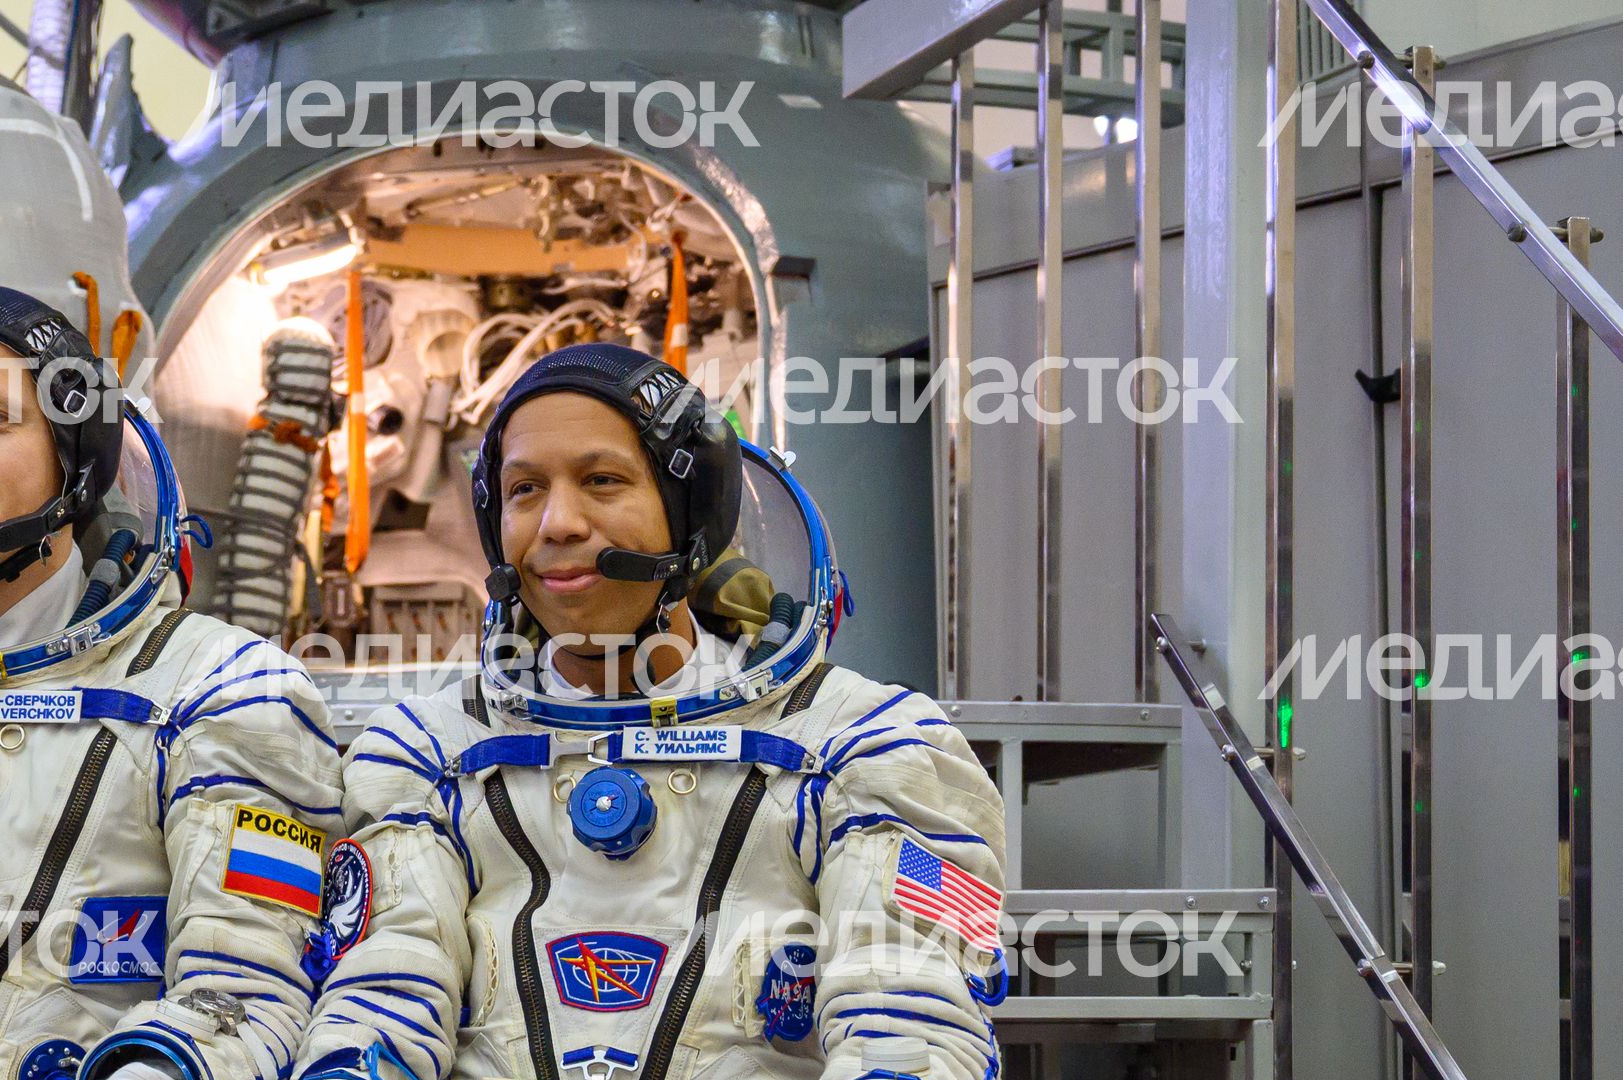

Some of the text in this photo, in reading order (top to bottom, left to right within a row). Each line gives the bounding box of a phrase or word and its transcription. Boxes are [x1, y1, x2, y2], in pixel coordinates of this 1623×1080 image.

[634, 730, 727, 742] C. WILLIAMS
[634, 743, 727, 754] К. УИЛЬЯМС
[236, 808, 322, 854] РОССИЯ
[78, 960, 159, 974] РОСКОСМОС
[770, 978, 812, 1004] NASA
